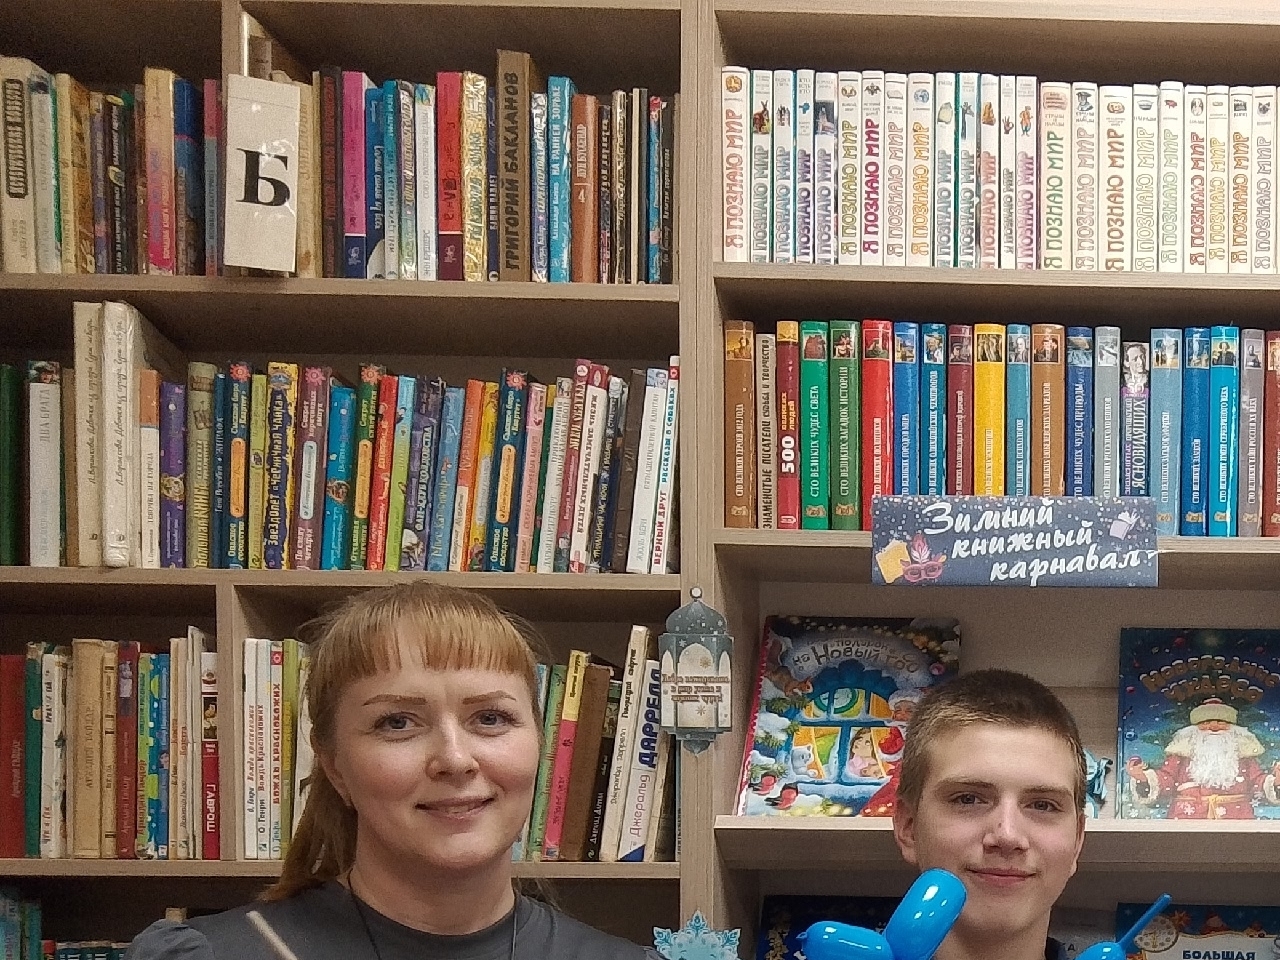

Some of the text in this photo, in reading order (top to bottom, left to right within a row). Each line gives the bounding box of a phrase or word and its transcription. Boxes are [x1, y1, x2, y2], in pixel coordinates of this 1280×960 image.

[551, 86, 560, 175] НА РАННЕЙ ЗОРЬКЕ
[236, 147, 290, 206] Б
[501, 72, 519, 270] ГРИГОРИЙ БАКЛАНОВ
[726, 109, 743, 248] Я ПОЗНАЮ МИР
[863, 119, 879, 254] Я ПОЗНАЮ МИР
[1044, 131, 1063, 269] Я ПОЗНАЮ МИР
[1106, 128, 1124, 271] Я ПОЗНАЮ МИР
[761, 339, 769, 381] ТВОРЧЕСТВО
[667, 387, 675, 426] собаках
[762, 421, 771, 464] ПИСАТЕЛИ
[810, 386, 821, 497] СТО ВЕЛИКИХ ЧУДЕС СВЕТА
[839, 367, 849, 495] СТО ВЕЛИКИХ ЗАГАДОК ИСТОРИИ
[1075, 422, 1084, 447] ЧУДЕС
[1133, 399, 1145, 488] ЯСНОВИДЯЩИХ
[662, 438, 671, 483] рассказы
[782, 436, 795, 473] 500
[1075, 449, 1083, 483] ВЕЛИКИХ
[658, 491, 666, 518] ДРУГ
[763, 469, 772, 529] ЗНАМЕНИТЫЕ
[922, 497, 1053, 534] Зимний
[654, 521, 663, 564] ВЕРНЫЙ
[952, 520, 1093, 558] книжный
[990, 544, 1140, 586] карнавал
[812, 643, 879, 665] Новый
[629, 669, 660, 837] Джеральд ДАРРЕЛЛ
[207, 784, 216, 832] ГАВРОШ
[1182, 951, 1255, 960] БОЛЬШАЯ
